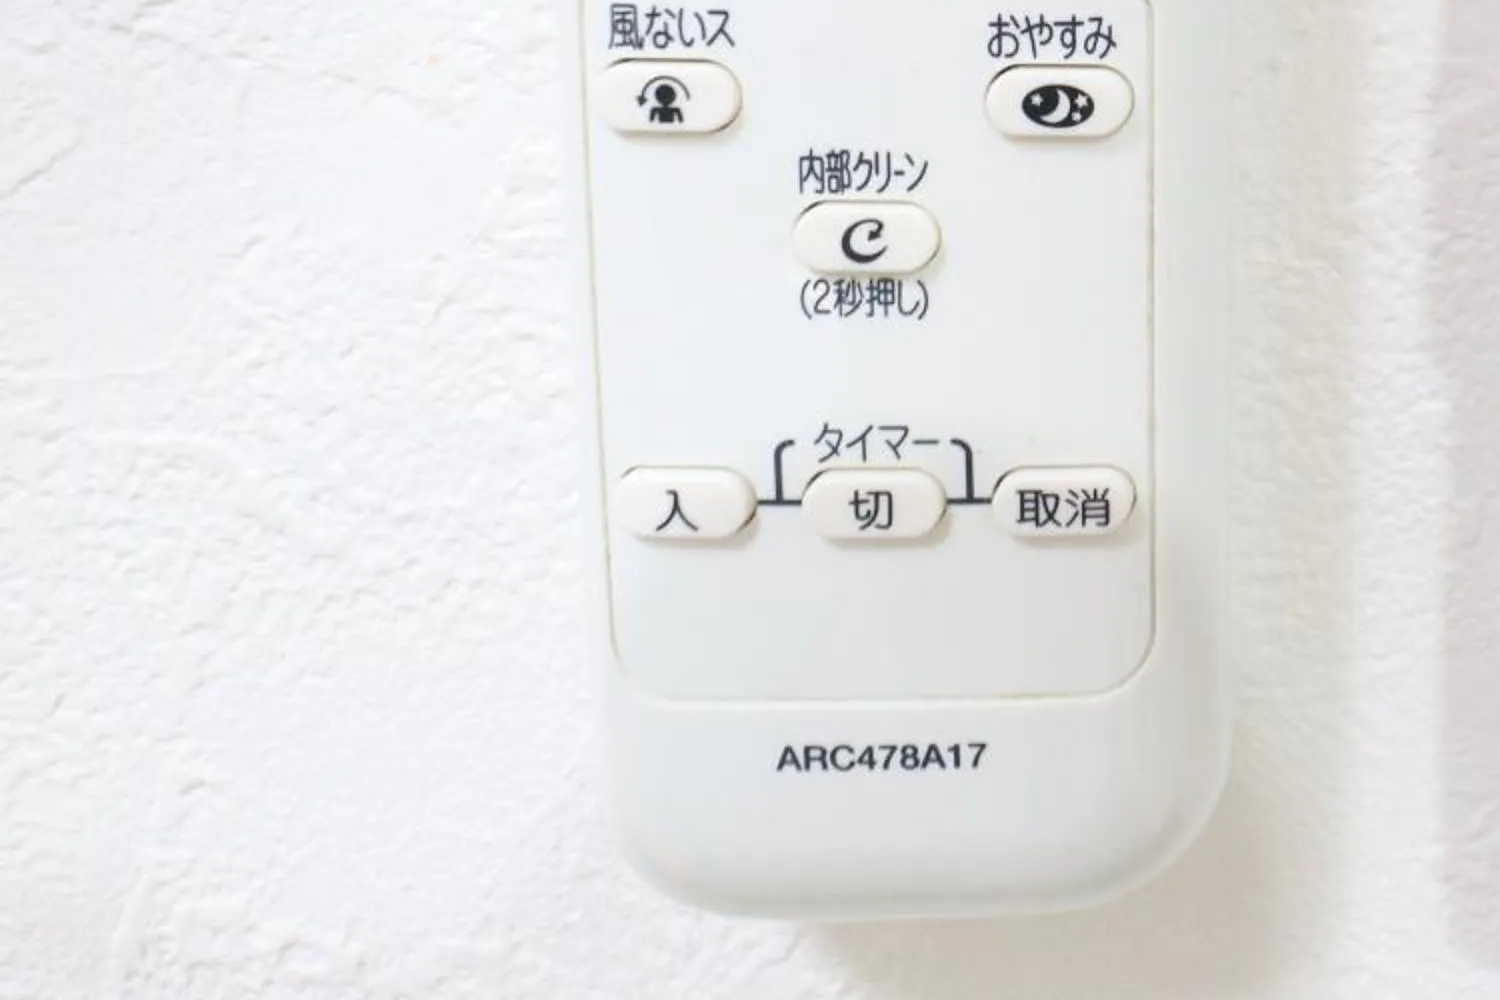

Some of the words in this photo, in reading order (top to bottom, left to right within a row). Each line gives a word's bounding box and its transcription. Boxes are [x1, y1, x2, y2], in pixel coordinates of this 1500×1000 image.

[609, 3, 735, 50] 風ないス
[988, 14, 1116, 59] おやすみ
[799, 149, 928, 194] 内部クリーン
[814, 423, 939, 463] タイマー
[656, 490, 698, 531] 入
[849, 490, 893, 530] 切
[1017, 488, 1110, 527] 取消
[777, 743, 986, 771] ARC478A17
